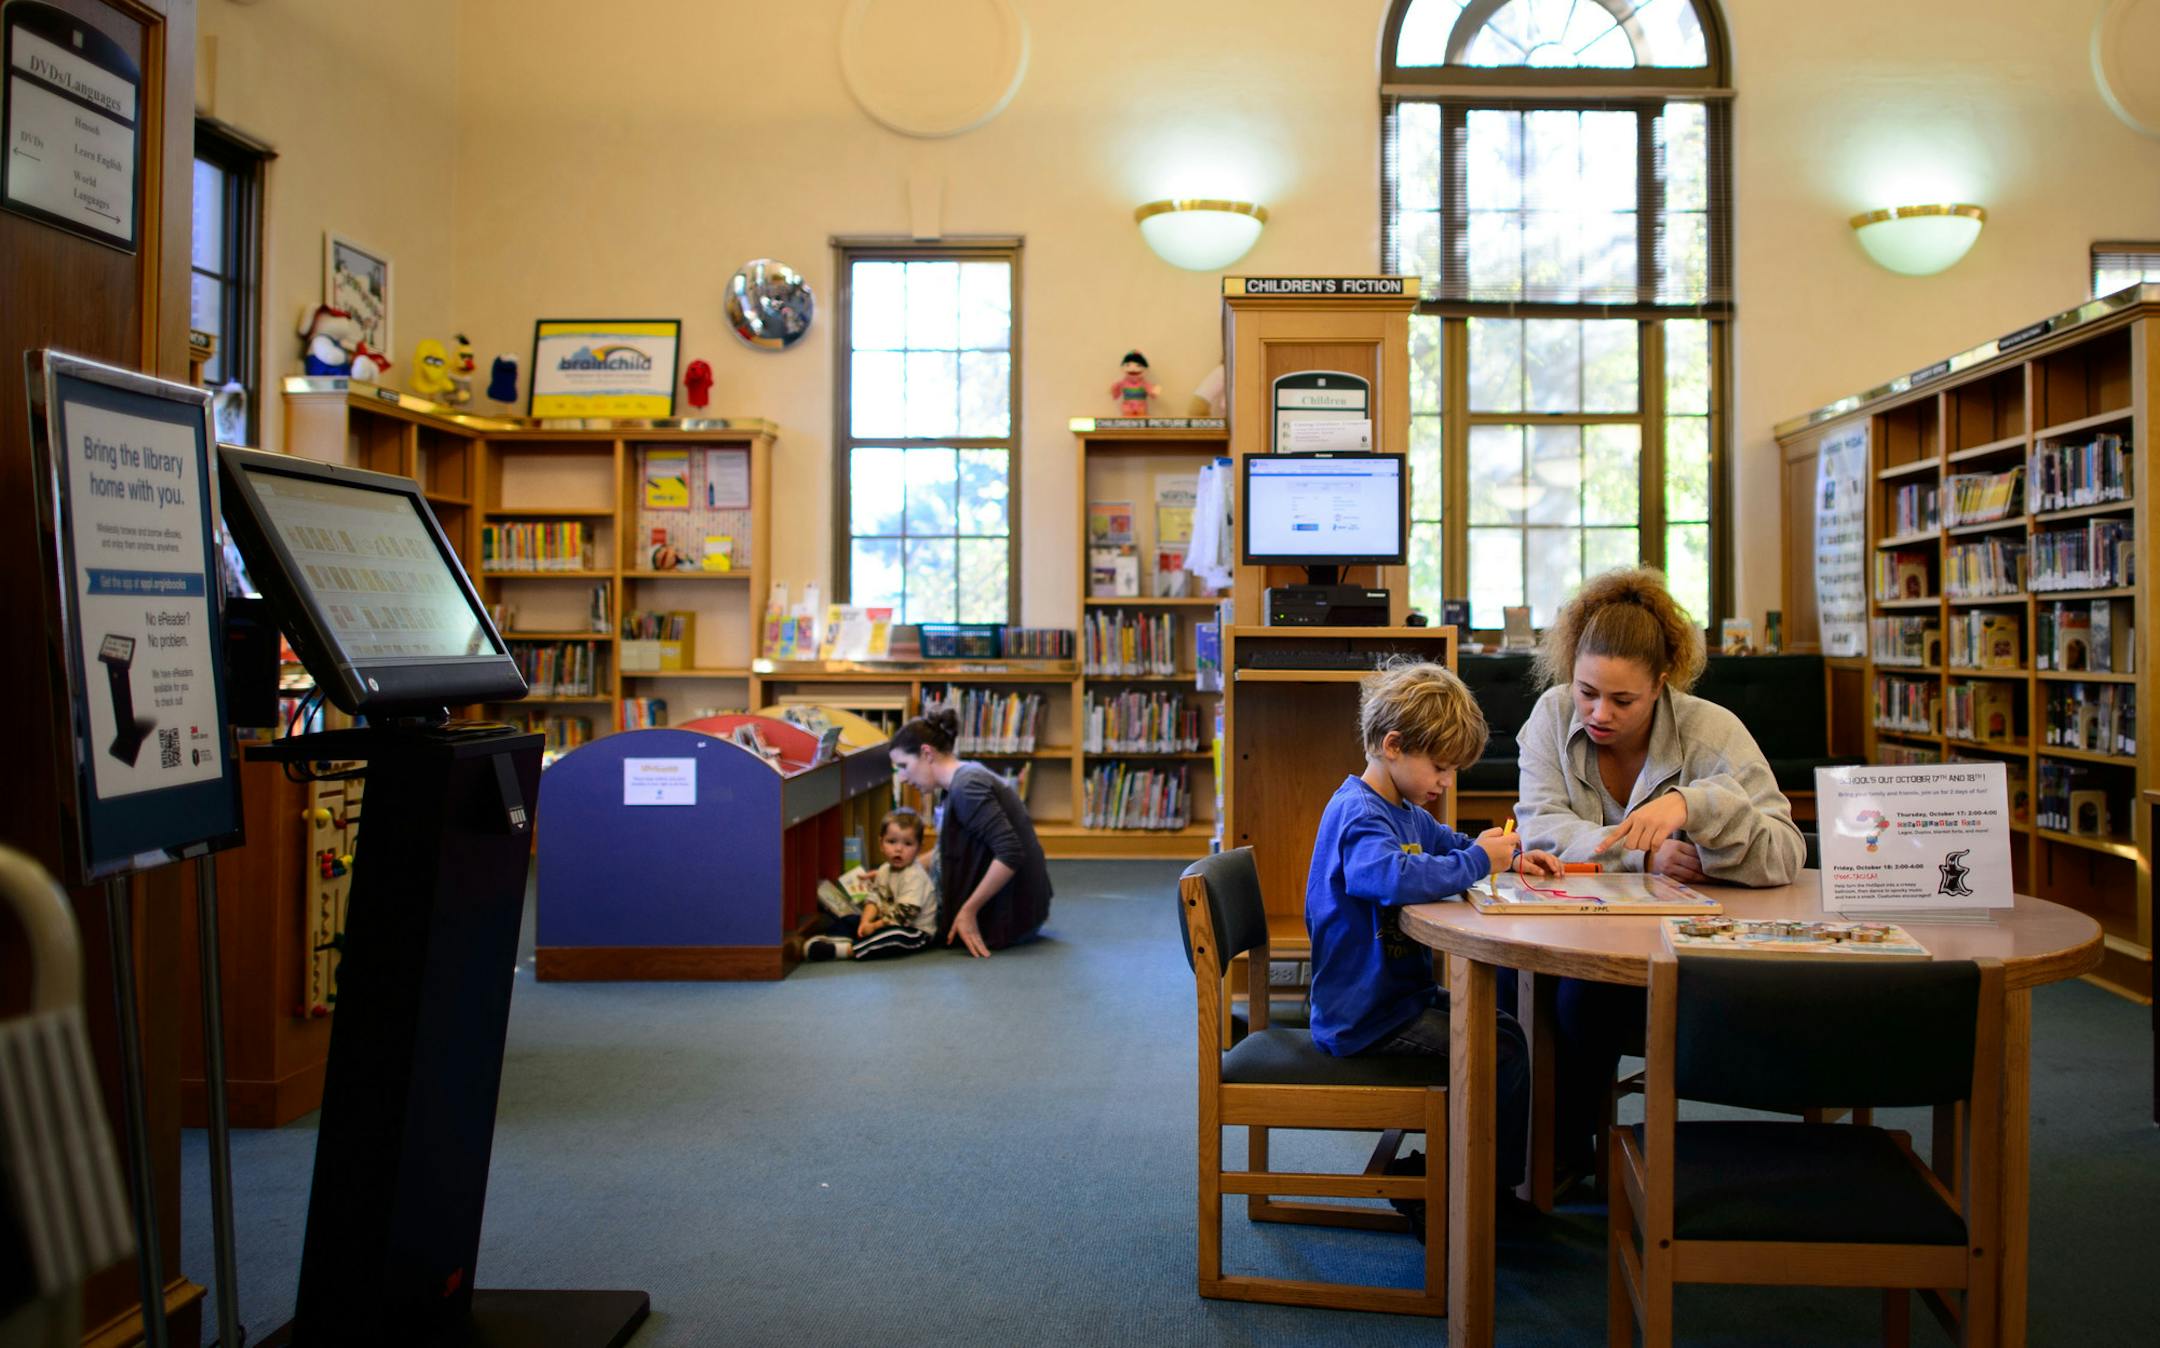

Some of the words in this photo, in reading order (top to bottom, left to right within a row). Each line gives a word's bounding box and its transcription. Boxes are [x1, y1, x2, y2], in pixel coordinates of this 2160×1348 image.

[30, 55, 122, 112] DVDs/Languages
[20, 130, 45, 149] DVDs
[74, 143, 97, 162] Learn
[96, 151, 123, 173] English
[73, 170, 97, 188] World
[73, 188, 110, 210] Languages
[1246, 279, 1337, 293] CHILDREN'S
[1342, 279, 1402, 293] FICTION
[559, 355, 652, 370] brainchild
[1301, 395, 1347, 406] Children
[84, 436, 117, 470] Bring
[119, 443, 140, 469] the
[143, 447, 184, 480] library
[90, 472, 125, 500] home
[128, 478, 154, 502] with
[157, 485, 185, 509] you.
[145, 611, 157, 626] No
[158, 611, 191, 626] eReader?
[147, 633, 159, 648] No
[160, 632, 189, 651] problem.
[1877, 775, 1895, 784] OUT
[1895, 774, 1931, 784] OCTOBER
[1948, 773, 1966, 783] AND
